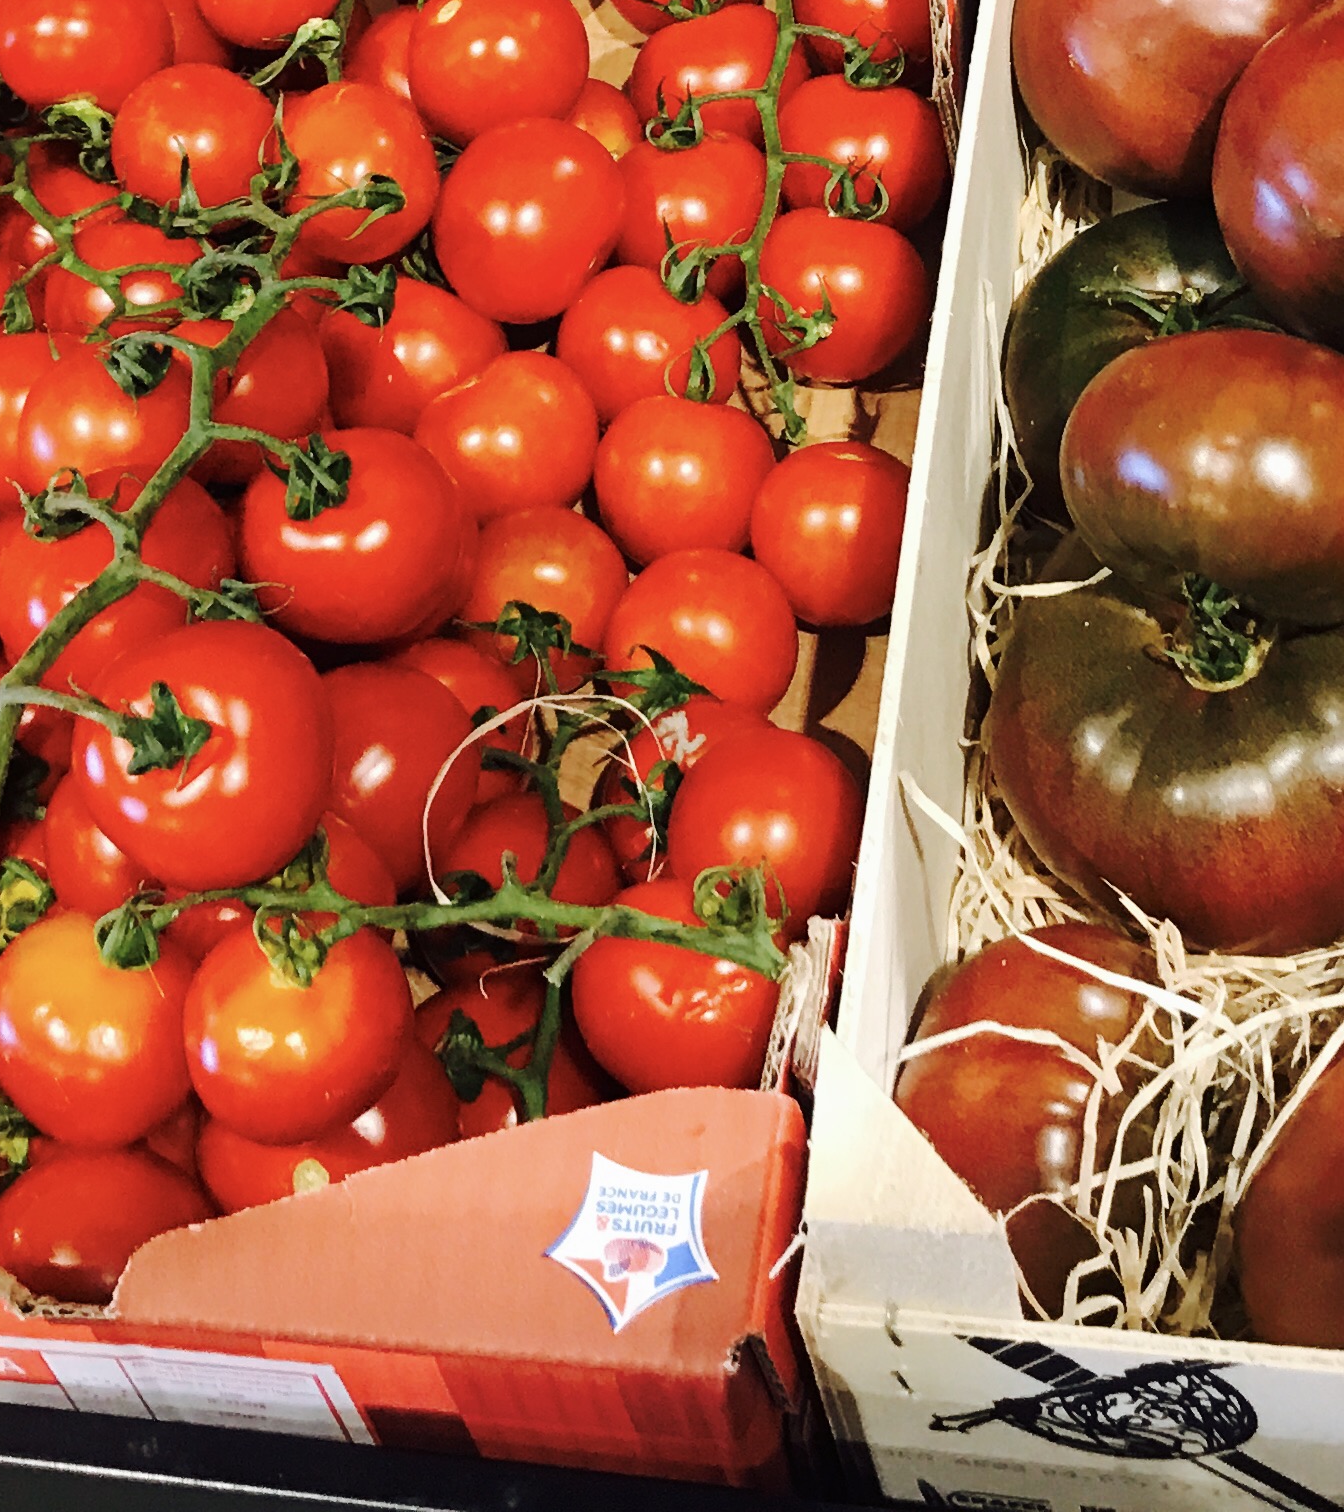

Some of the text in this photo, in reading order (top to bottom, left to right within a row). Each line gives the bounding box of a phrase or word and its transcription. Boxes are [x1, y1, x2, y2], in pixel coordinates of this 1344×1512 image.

[599, 1186, 682, 1204] DE FRANCE
[596, 1200, 679, 1220] LEGUMES
[596, 1214, 678, 1236] FRUITS &
